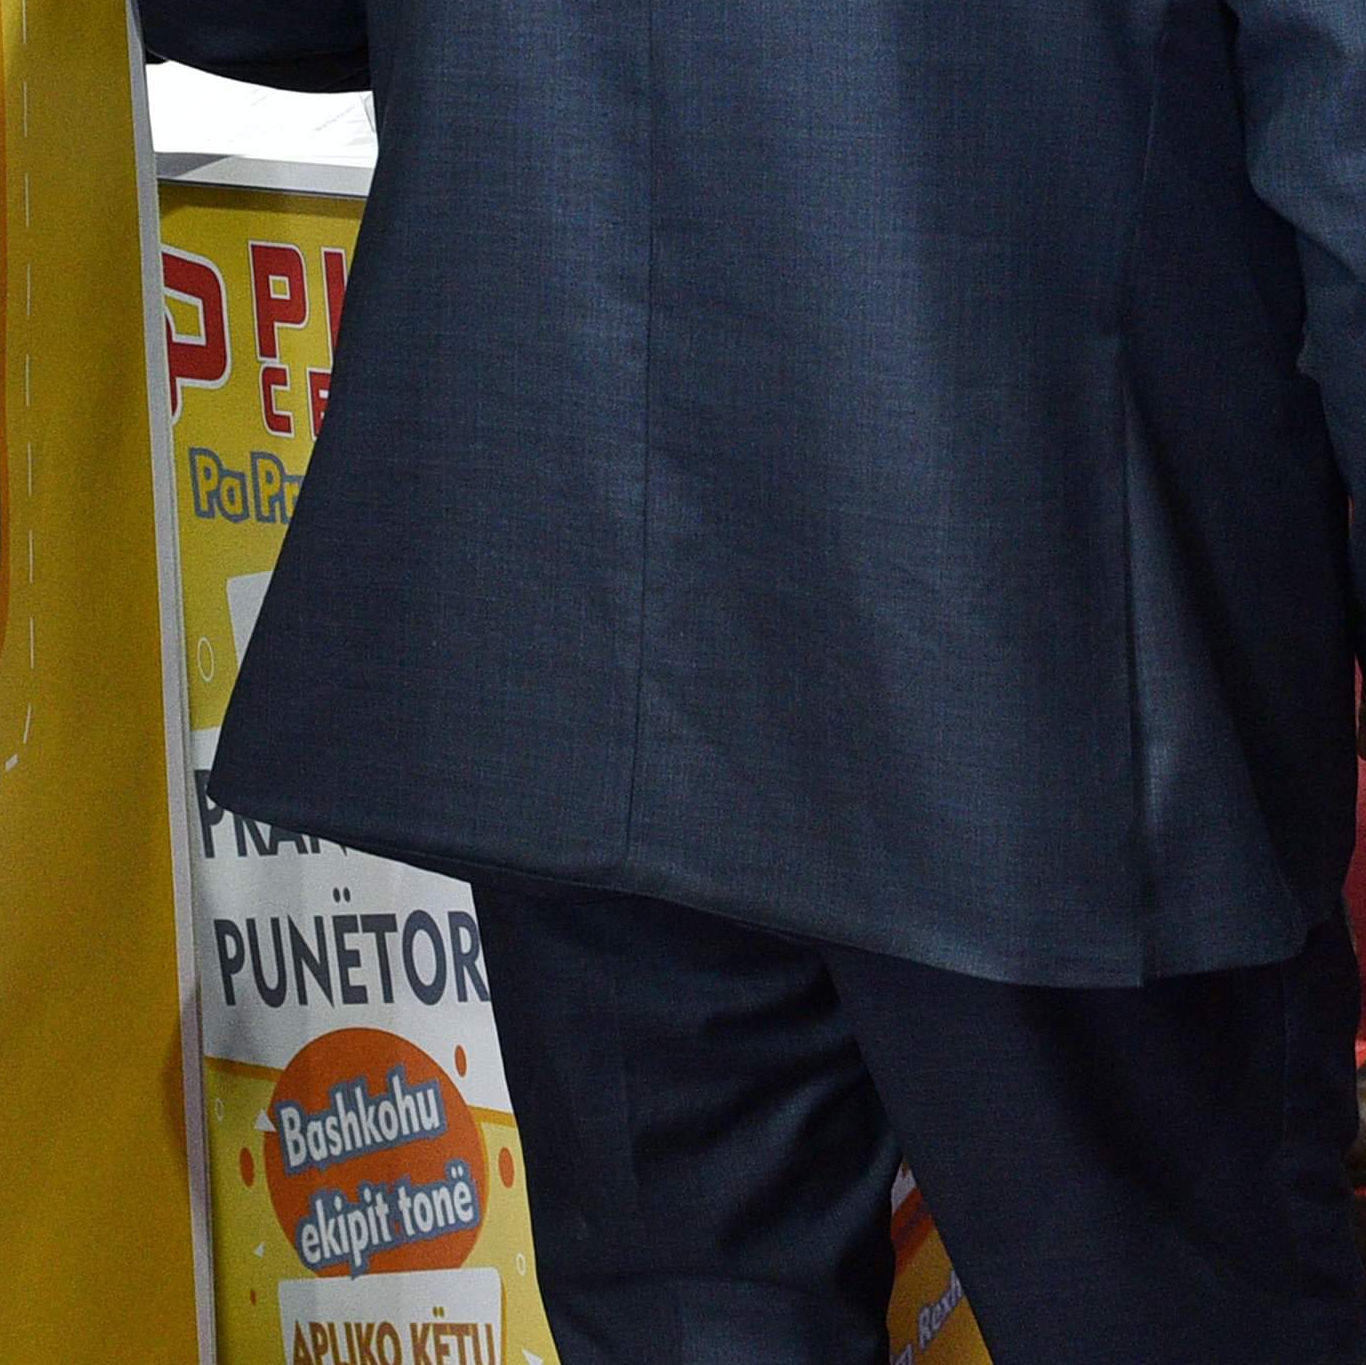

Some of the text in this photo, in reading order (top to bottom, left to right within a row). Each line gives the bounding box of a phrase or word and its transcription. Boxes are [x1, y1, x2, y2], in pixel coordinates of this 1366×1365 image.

[188, 447, 250, 526] Pa
[213, 886, 492, 1008] PUNËTOR
[277, 1067, 447, 1173] Bashkohu
[297, 1161, 480, 1276] ekipit tonë
